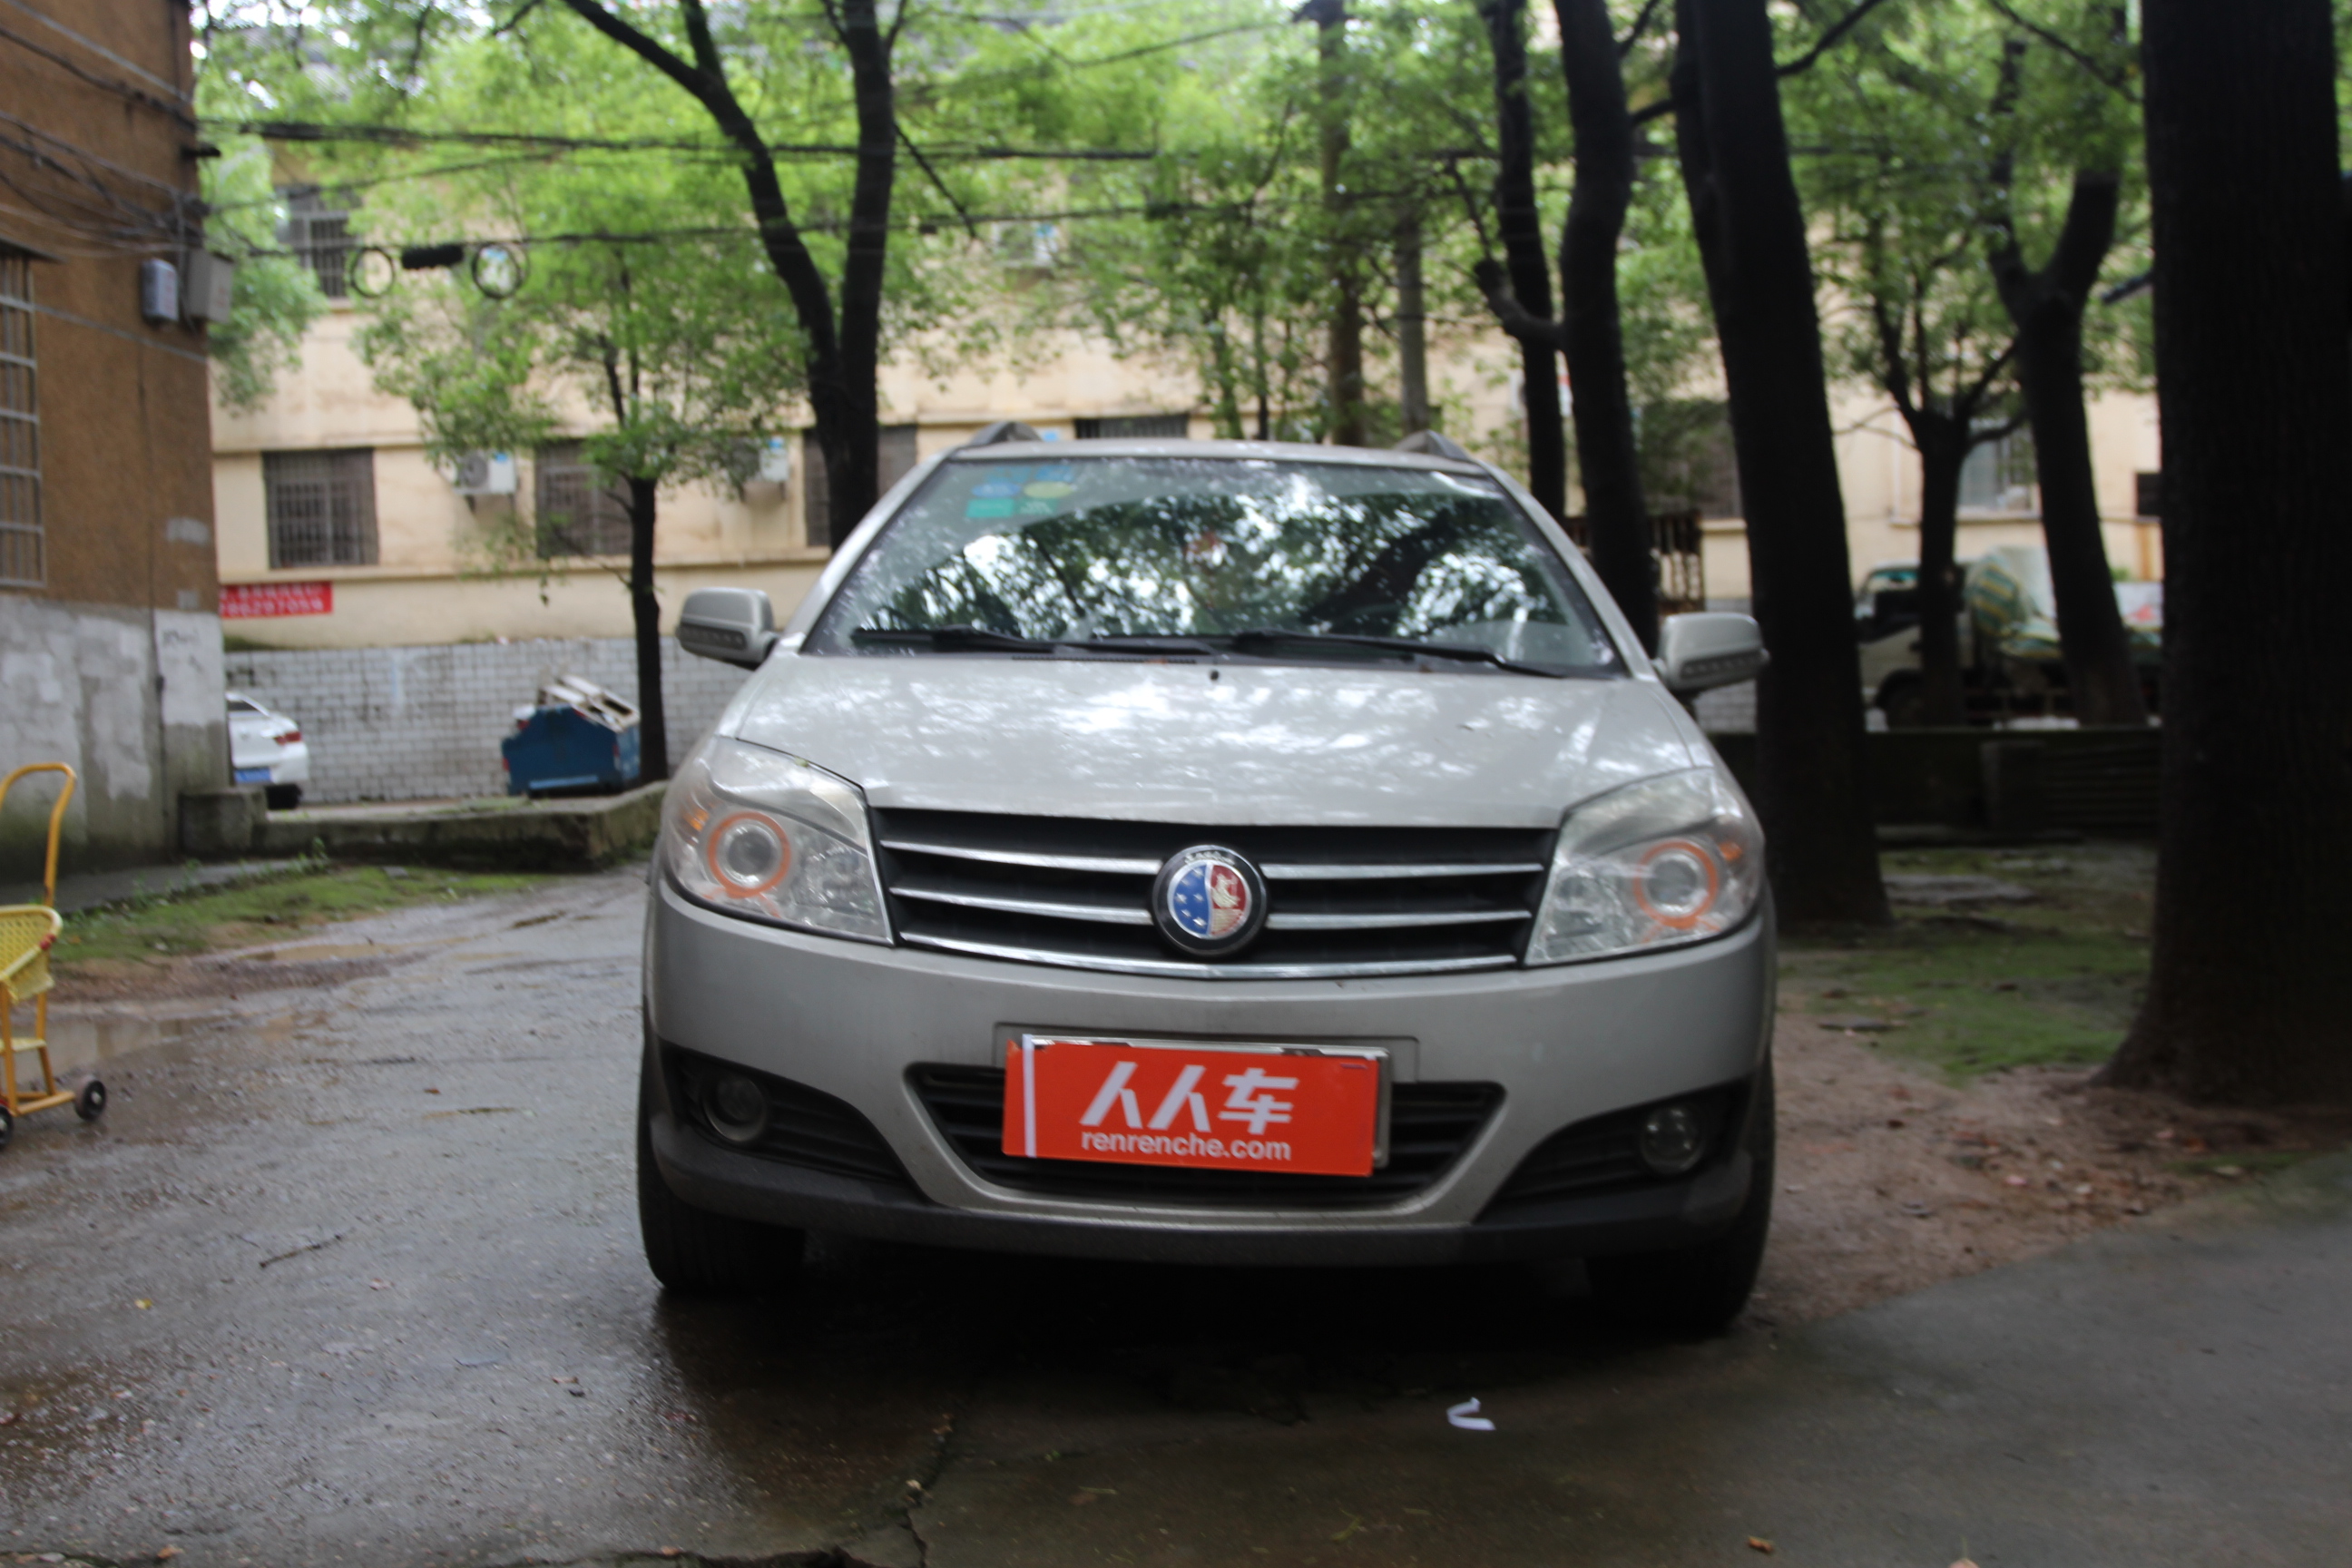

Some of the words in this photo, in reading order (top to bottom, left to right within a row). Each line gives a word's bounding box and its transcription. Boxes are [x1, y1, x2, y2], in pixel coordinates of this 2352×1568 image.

[1079, 1061, 1299, 1135] 人人车
[1081, 1132, 1292, 1161] renrenche.com
